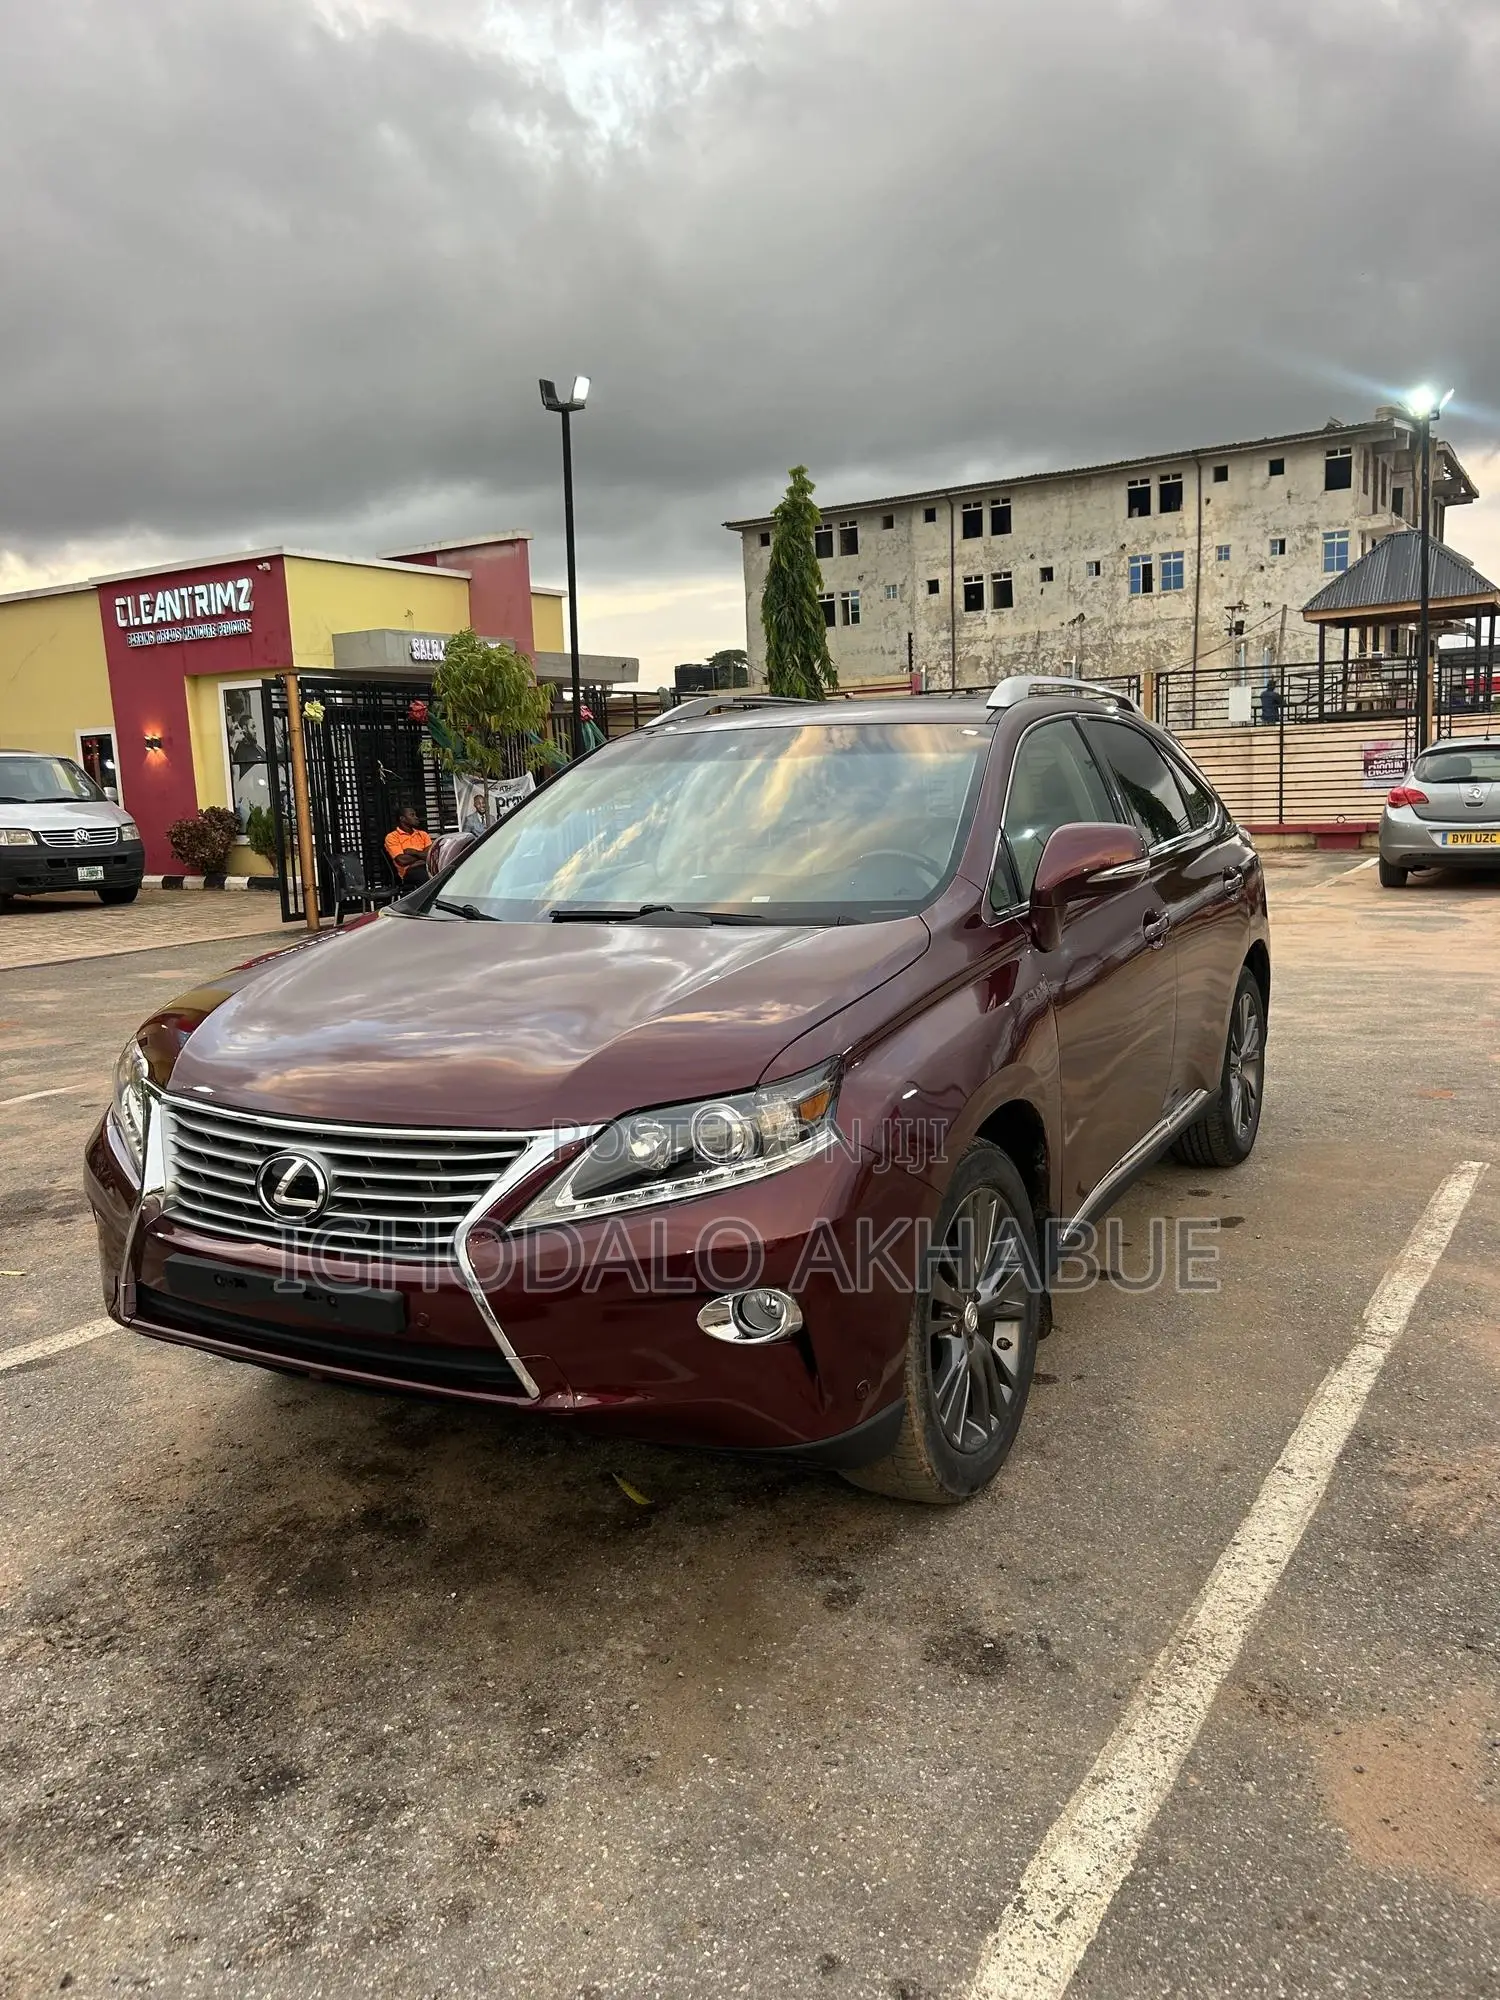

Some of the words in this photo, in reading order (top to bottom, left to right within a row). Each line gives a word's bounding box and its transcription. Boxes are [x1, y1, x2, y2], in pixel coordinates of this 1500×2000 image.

[115, 577, 254, 627] CLEANTRIMZ
[127, 630, 155, 648] BARBING
[156, 627, 181, 645] DREADS
[182, 622, 217, 641] MANICURE
[217, 619, 252, 638] PEDICURE
[1452, 833, 1472, 844] BY11
[1475, 833, 1497, 843] UZC
